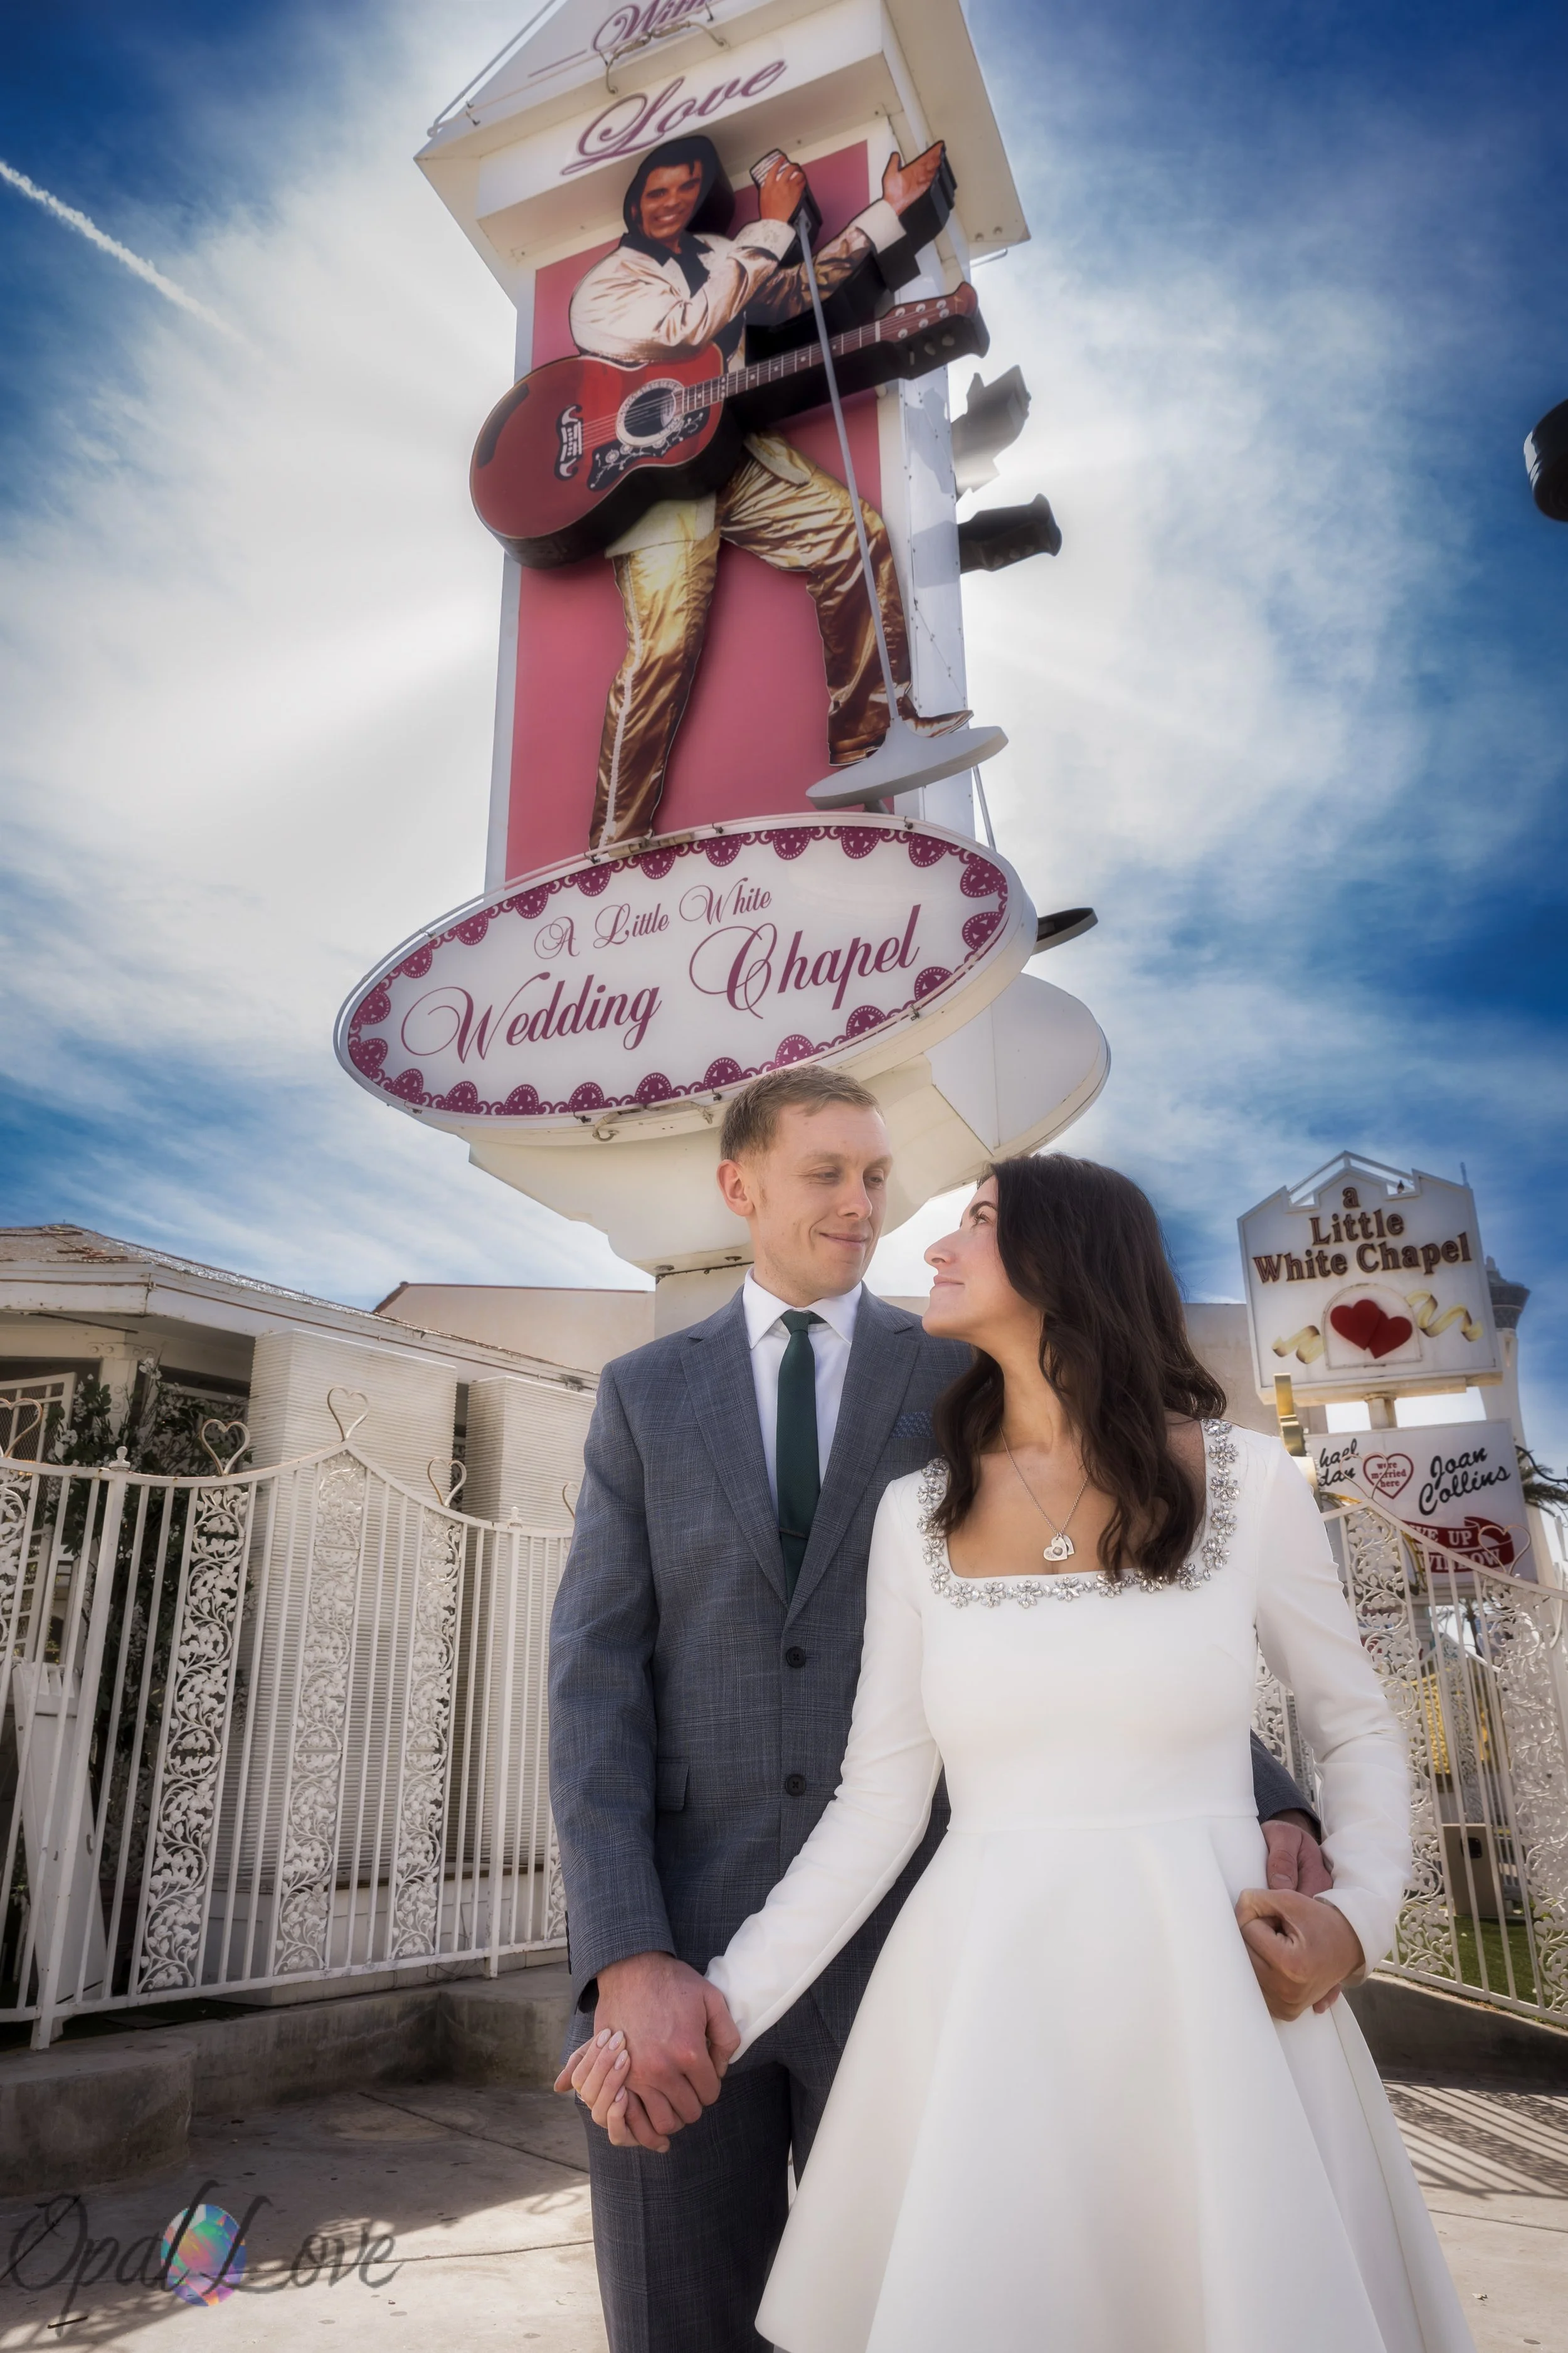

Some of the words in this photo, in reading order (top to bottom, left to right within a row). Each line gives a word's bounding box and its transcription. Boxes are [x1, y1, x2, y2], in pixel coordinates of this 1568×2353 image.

[560, 60, 788, 176] Love
[534, 916, 580, 960] A
[593, 903, 670, 949] Little
[679, 878, 772, 925] White
[401, 972, 663, 1064] Wedding
[689, 904, 921, 1019] Chapel
[1342, 1186, 1360, 1209] a
[1309, 1208, 1405, 1246] Little
[1252, 1249, 1348, 1284] White
[1356, 1232, 1472, 1275] Chapel
[1319, 1438, 1359, 1468] hael
[1430, 1447, 1488, 1490] Joan
[1318, 1467, 1356, 1487] dan
[1380, 1479, 1400, 1488] here
[1419, 1465, 1511, 1516] Collins
[1448, 1531, 1471, 1546] UP
